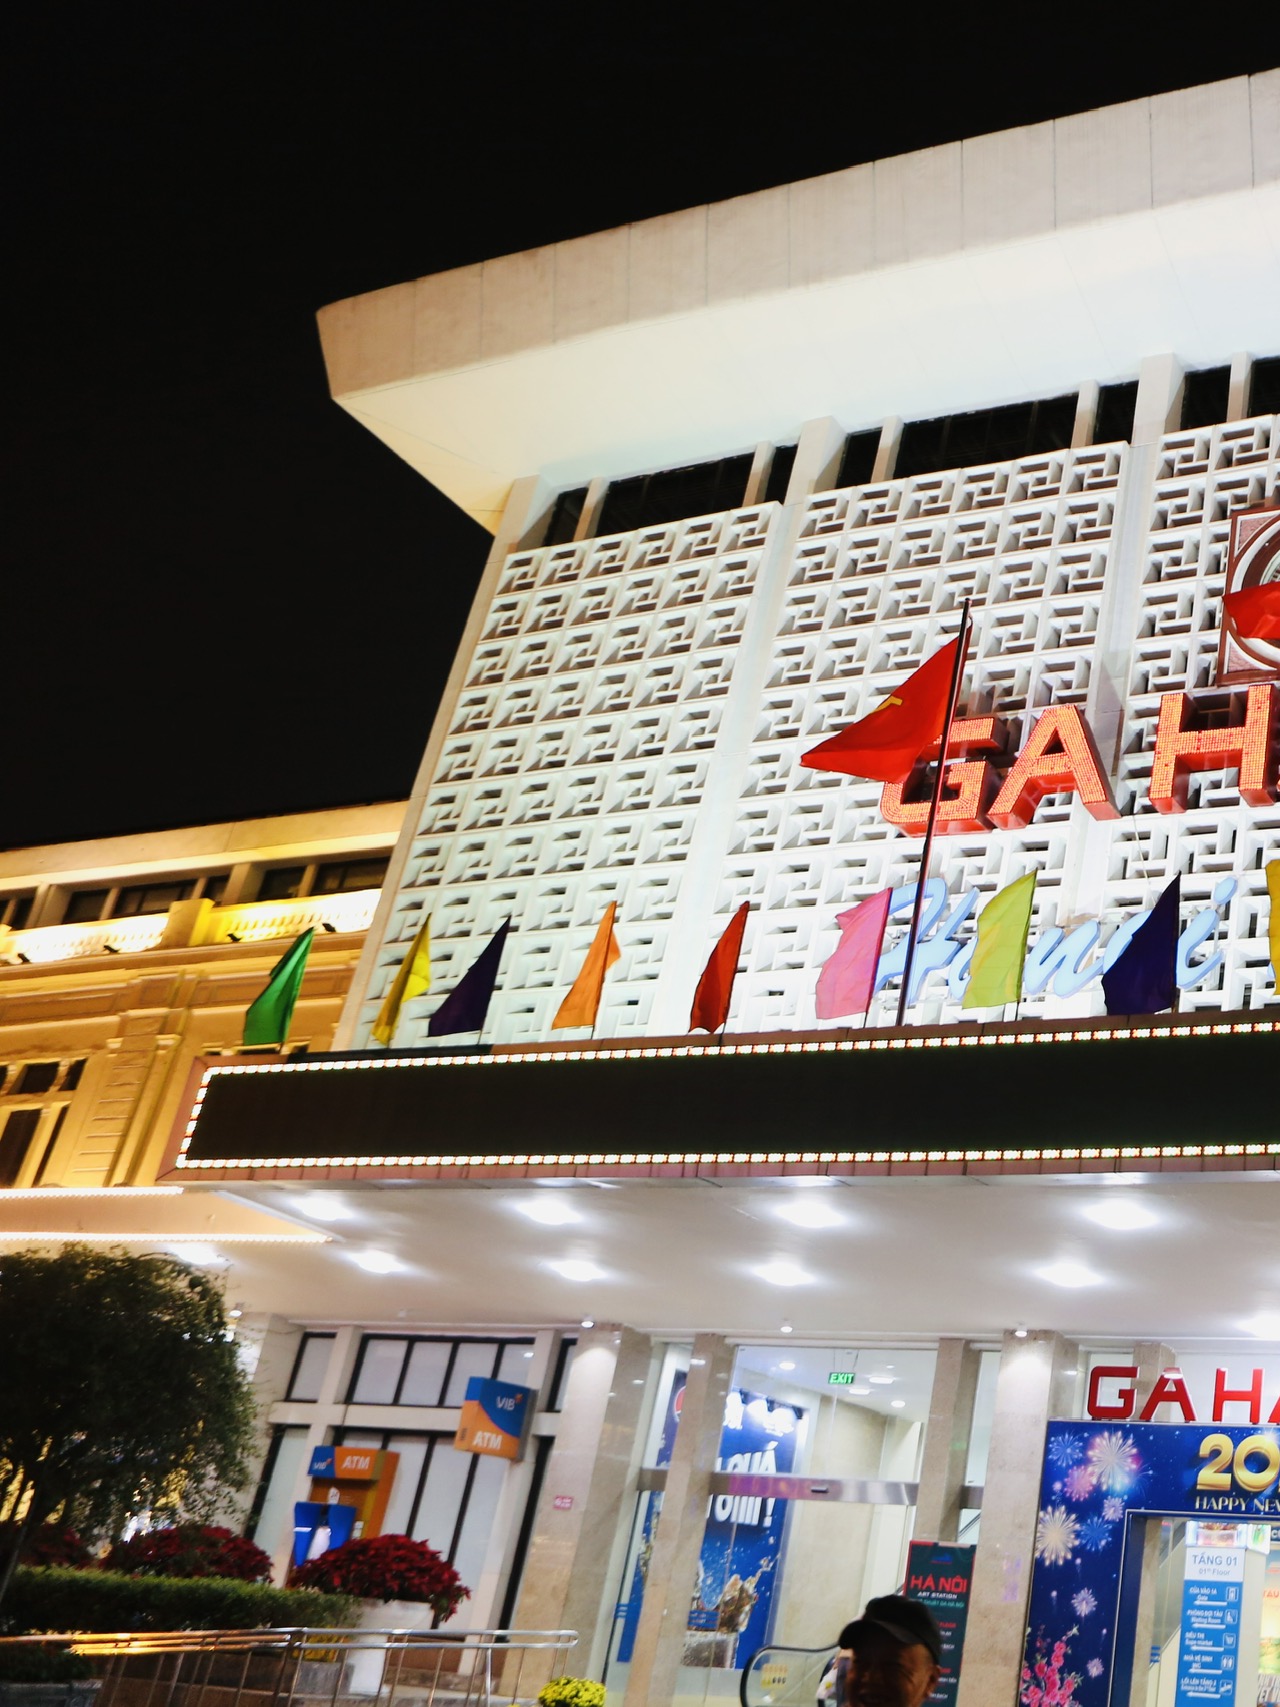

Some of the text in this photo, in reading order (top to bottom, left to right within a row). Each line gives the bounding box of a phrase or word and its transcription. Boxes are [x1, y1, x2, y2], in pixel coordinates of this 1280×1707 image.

[880, 703, 1121, 838] GA
[830, 1373, 855, 1384] EXIT
[1087, 1365, 1197, 1423] GA
[496, 1396, 515, 1411] VIB
[472, 1430, 503, 1451] ATM
[313, 1461, 328, 1470] VIB
[341, 1455, 371, 1470] ATM
[1195, 1496, 1249, 1511] HAPPY
[1225, 1556, 1238, 1567] 01
[1212, 1568, 1231, 1576] Floor
